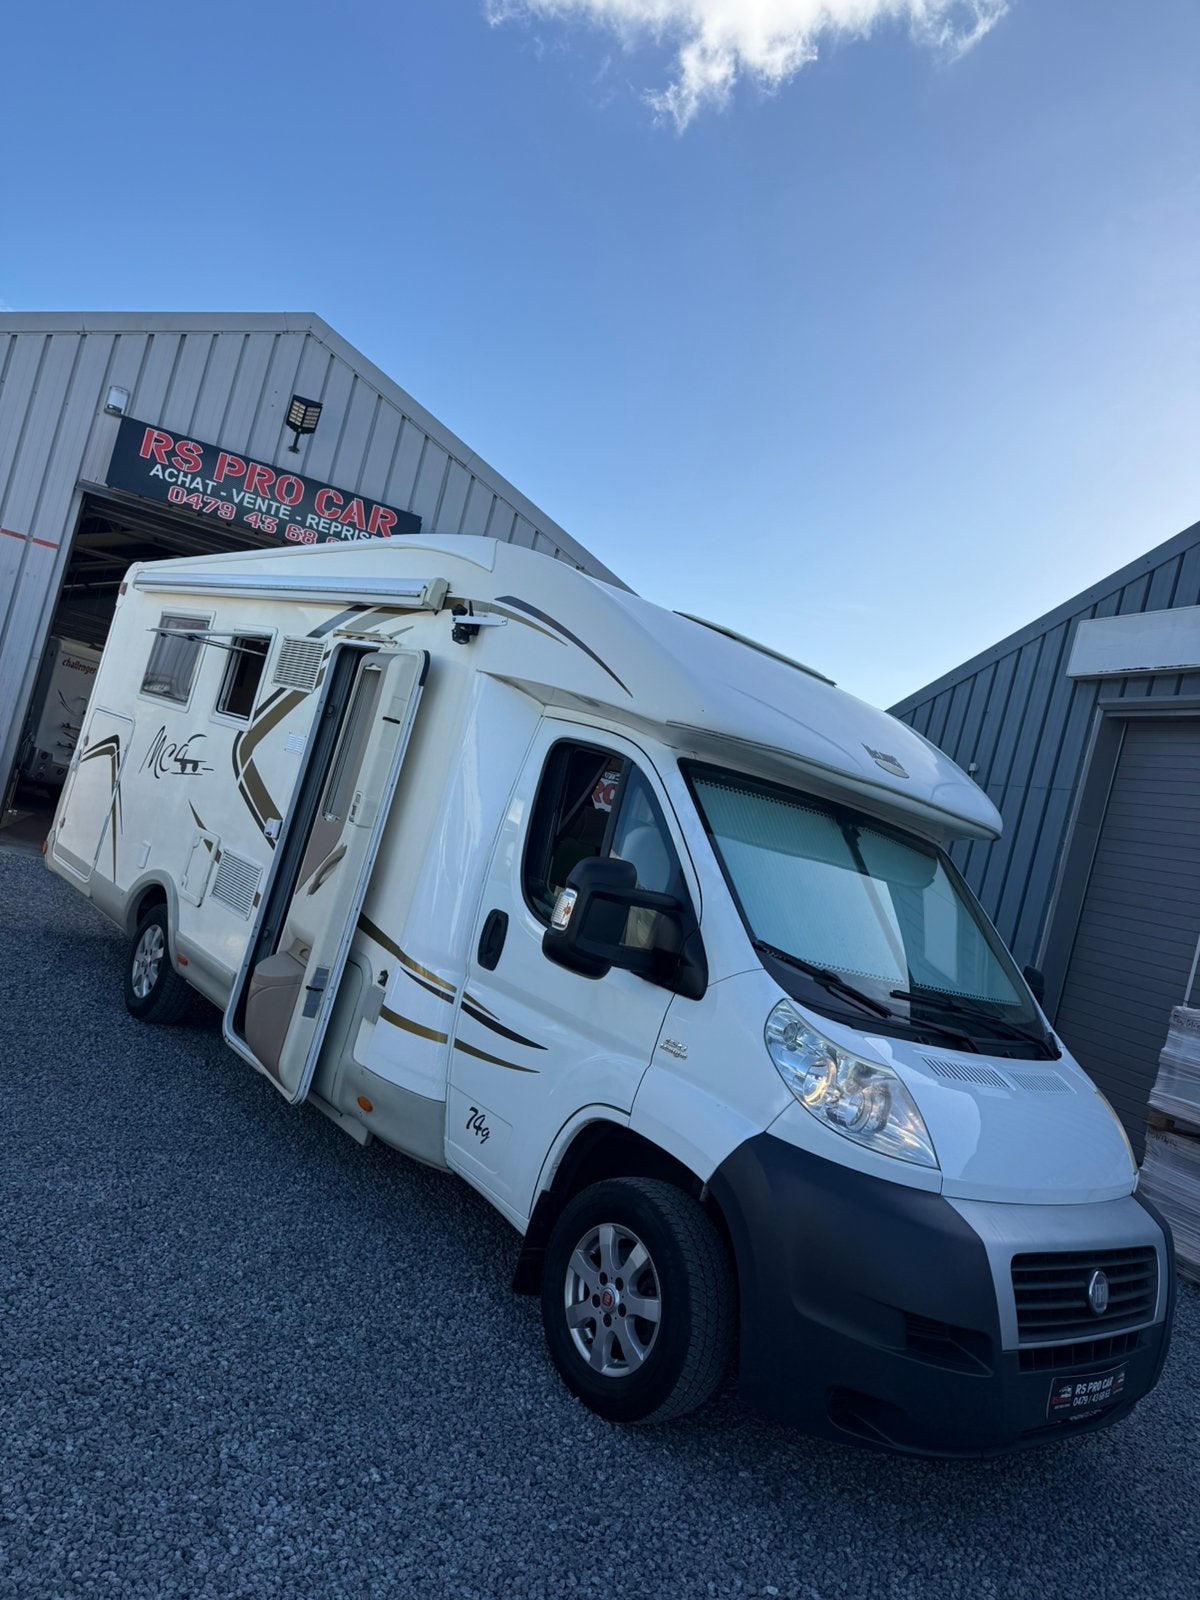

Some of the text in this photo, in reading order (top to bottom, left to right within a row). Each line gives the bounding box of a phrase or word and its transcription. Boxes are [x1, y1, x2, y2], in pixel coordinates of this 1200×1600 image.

[140, 427, 398, 537] RS PRO CAR
[149, 464, 217, 495] ACHAT
[232, 488, 291, 520] VENTE
[168, 485, 318, 545] 0479 43 68
[1072, 1395, 1088, 1407] 0479
[1075, 1383, 1087, 1395] RS
[1087, 1380, 1102, 1393] PRO
